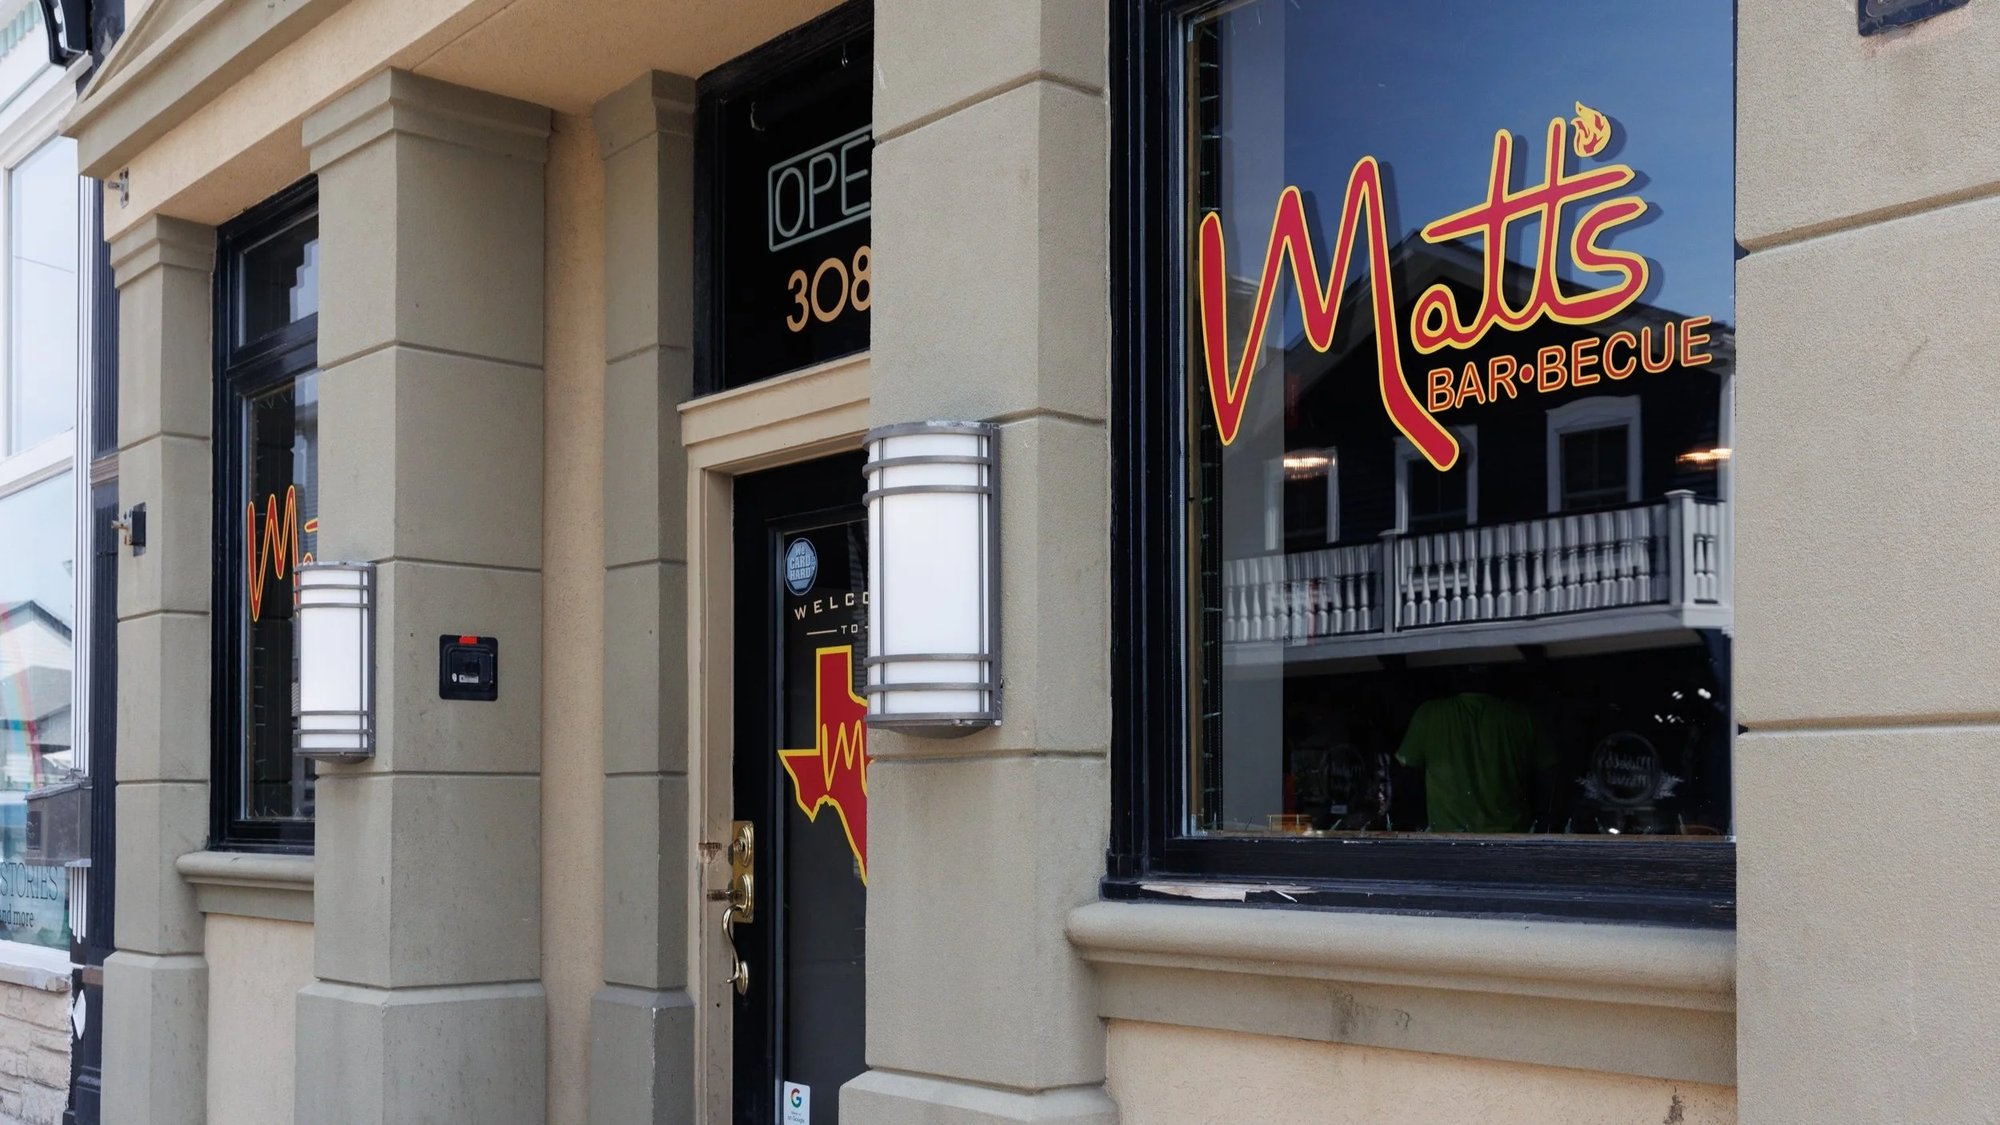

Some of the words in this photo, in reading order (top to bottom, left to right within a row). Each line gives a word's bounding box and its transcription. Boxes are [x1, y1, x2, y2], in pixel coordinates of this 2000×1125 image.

[786, 245, 872, 333] 308
[790, 555, 811, 570] CARD
[790, 567, 811, 581] HARD
[840, 623, 859, 635] TO
[0, 861, 59, 901] STORIES
[0, 903, 13, 926] nd
[13, 910, 35, 928] more
